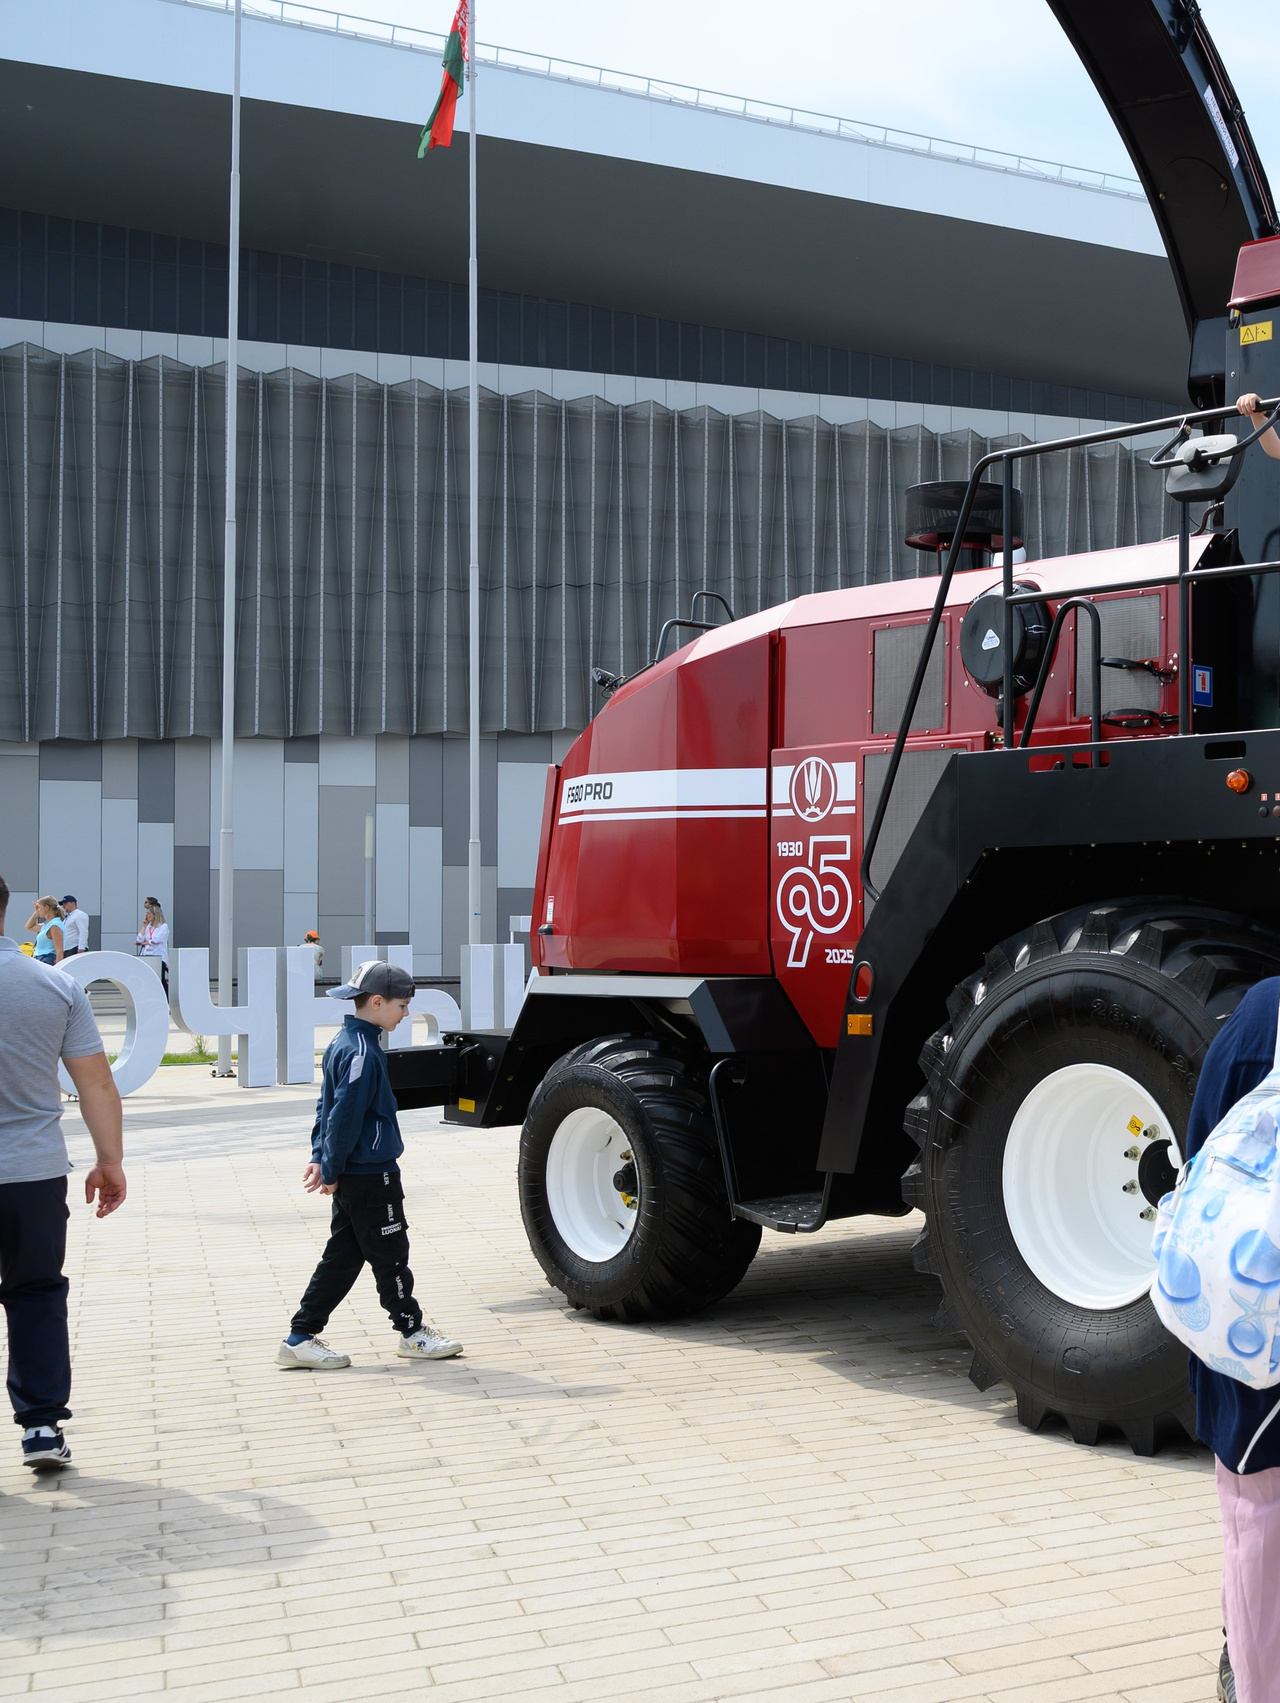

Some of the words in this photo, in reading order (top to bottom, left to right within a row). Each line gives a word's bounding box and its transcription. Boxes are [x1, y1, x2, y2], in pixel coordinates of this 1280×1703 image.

[584, 781, 613, 801] PRO
[776, 841, 803, 857] 1930
[824, 948, 854, 964] 2025
[1090, 998, 1142, 1034] 28.1
